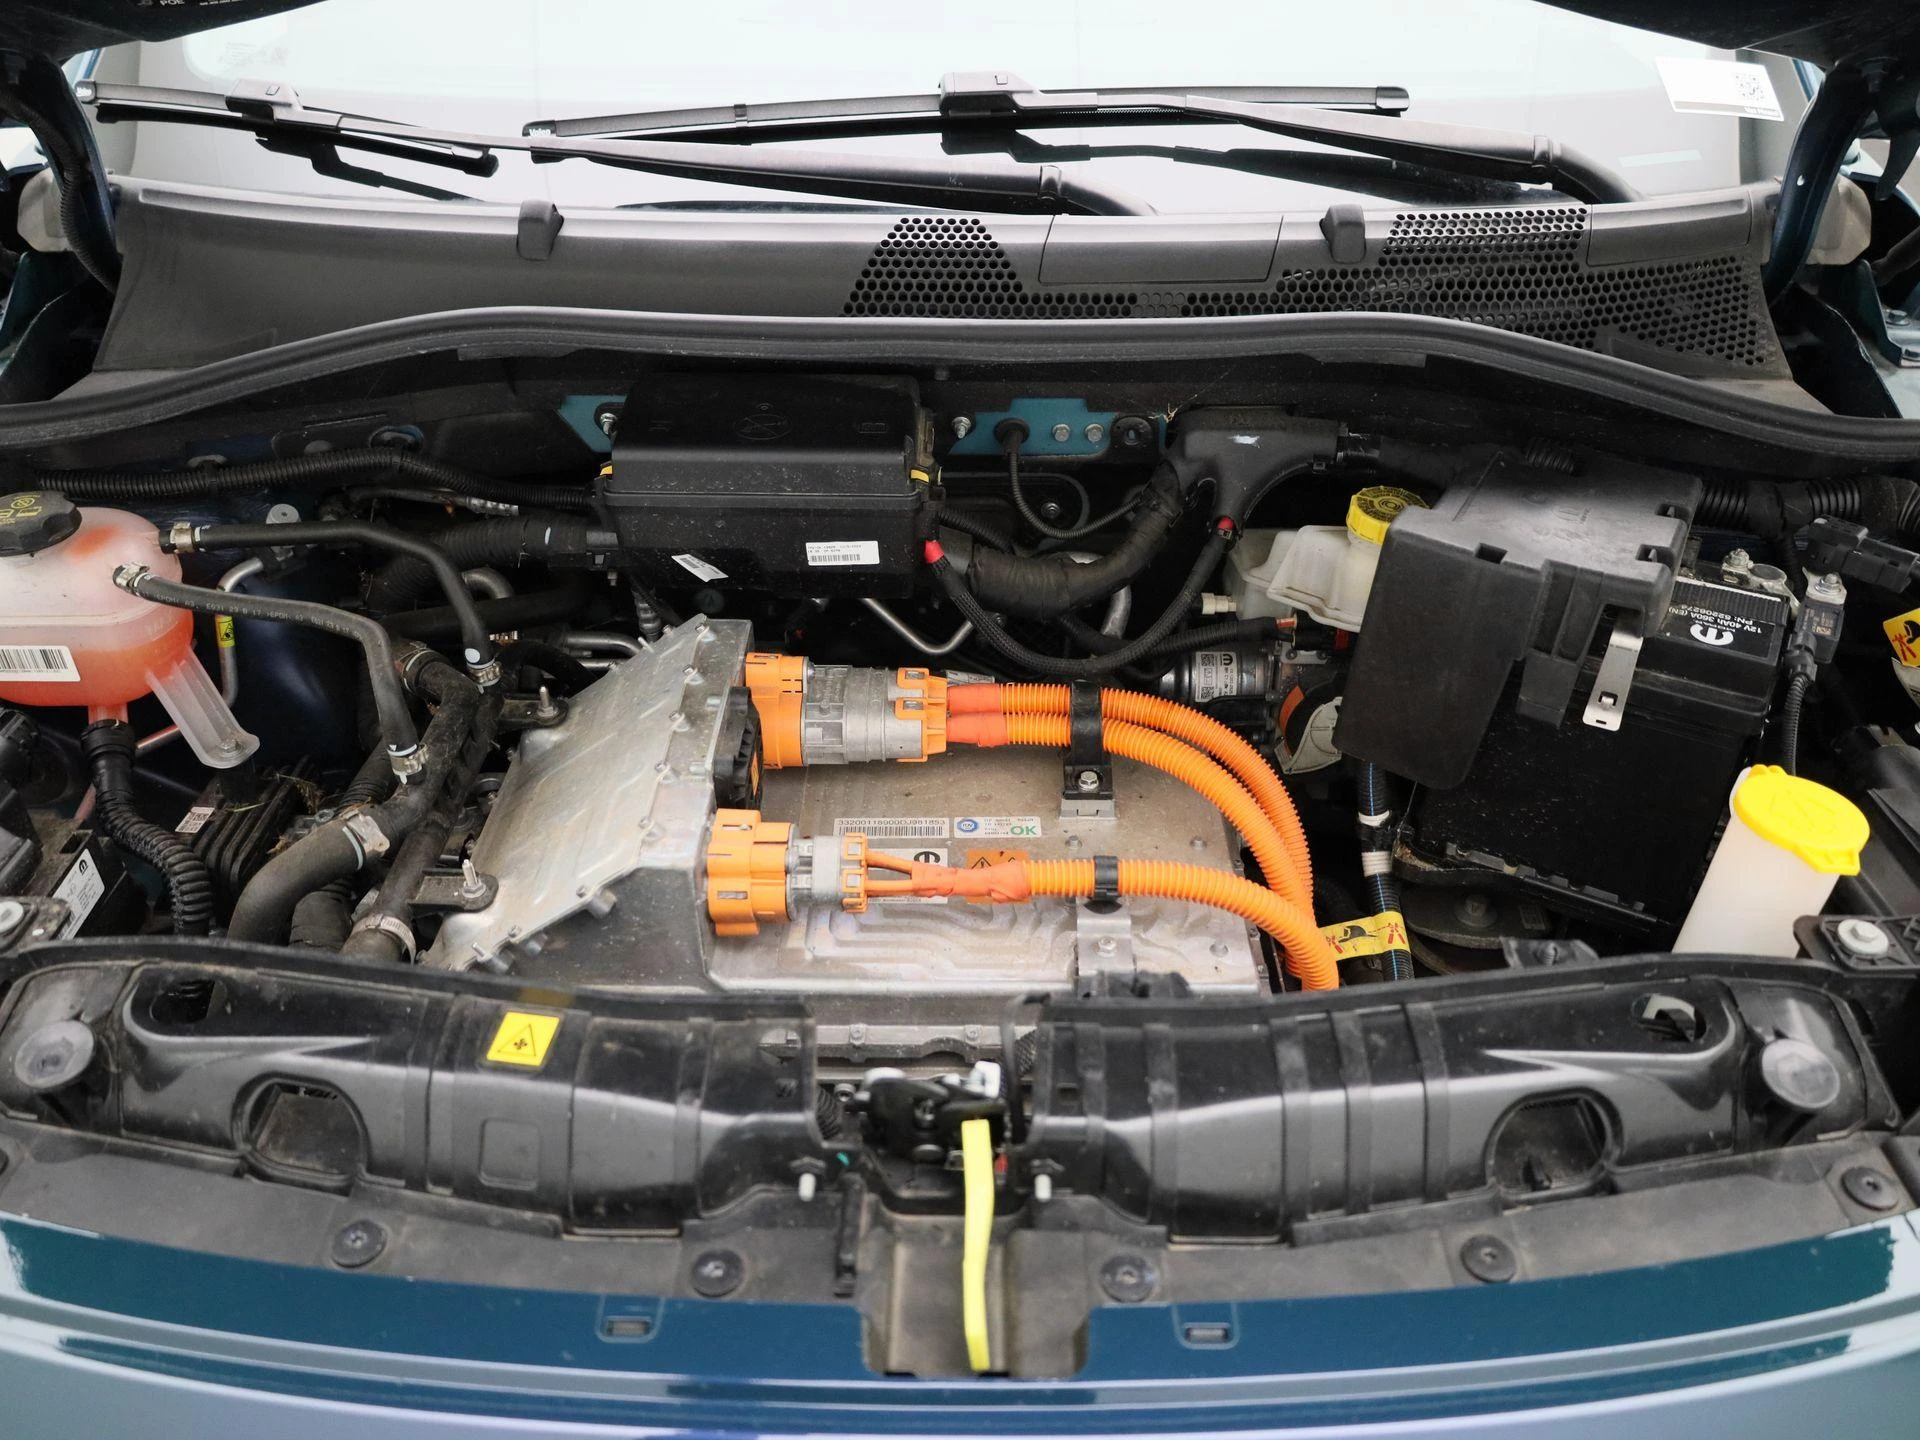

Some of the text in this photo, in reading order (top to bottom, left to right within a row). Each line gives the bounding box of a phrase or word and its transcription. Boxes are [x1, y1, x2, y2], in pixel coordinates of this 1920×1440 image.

[1668, 607, 1688, 616] (EN)
[1717, 618, 1742, 629] 40Ah
[1734, 616, 1753, 626] PN:
[1743, 625, 1762, 634] 12V
[1010, 825, 1037, 836] OK
